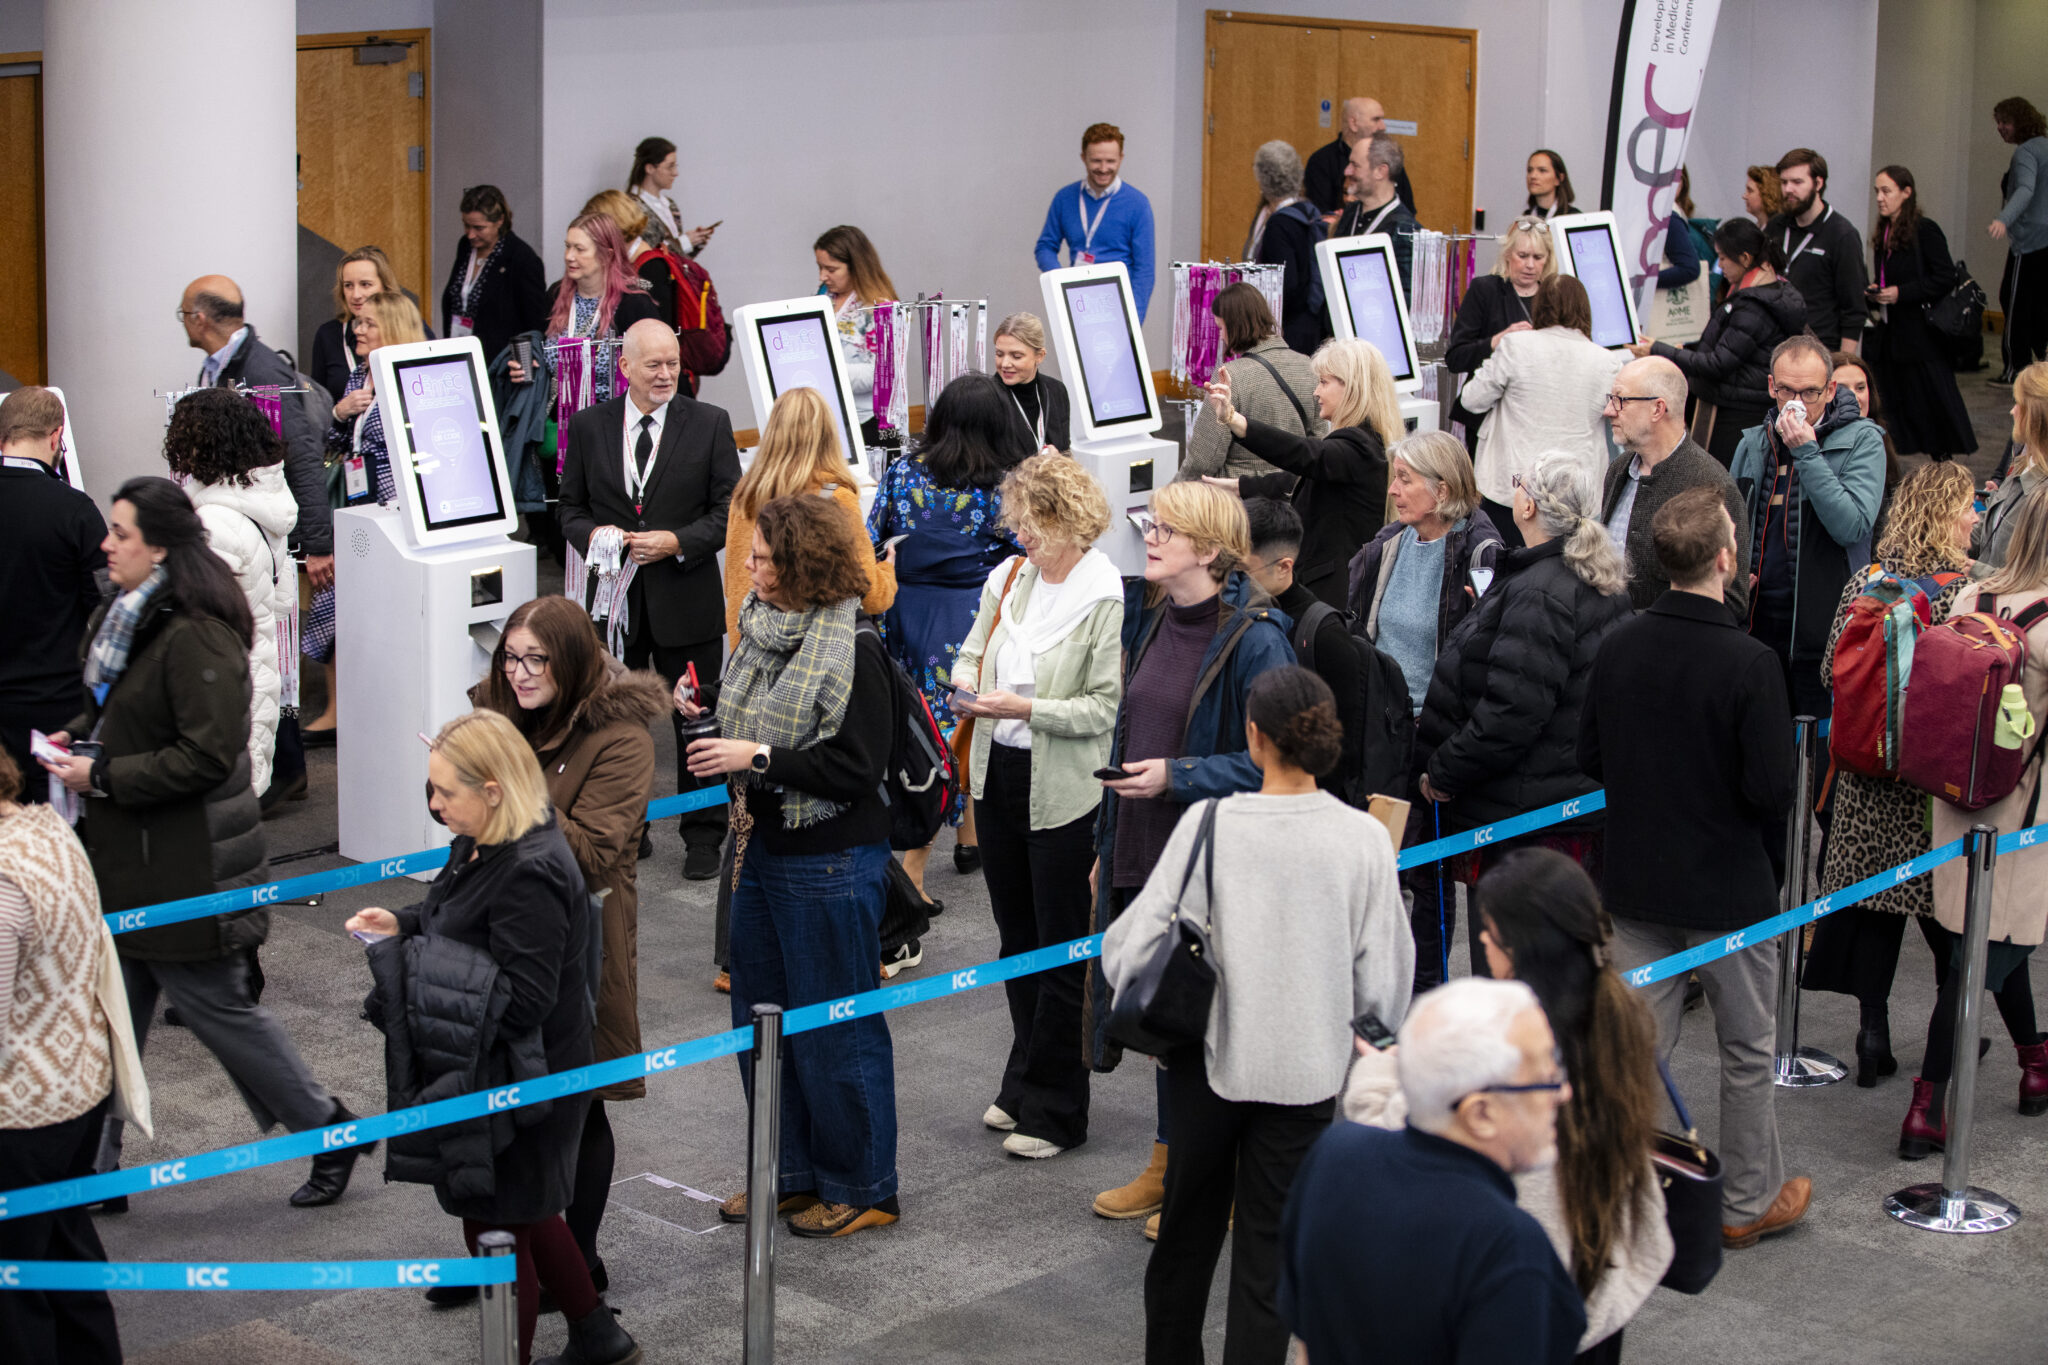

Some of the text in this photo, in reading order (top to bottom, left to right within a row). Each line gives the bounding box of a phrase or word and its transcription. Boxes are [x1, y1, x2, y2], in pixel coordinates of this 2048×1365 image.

[1663, 42, 1675, 54] in
[1679, 0, 1694, 55] Conferen
[1474, 800, 1580, 845] ICC ICC
[2019, 830, 2037, 846] ICC
[118, 858, 407, 930] ICC ICC ICC
[1632, 862, 1913, 986] ICC ICC ICC ICC
[829, 940, 1092, 1021] ICC ICC ICC
[150, 1049, 677, 1186] ICC ICC ICC ICC
[186, 1266, 229, 1287] ICC
[396, 1263, 441, 1284] ICC
